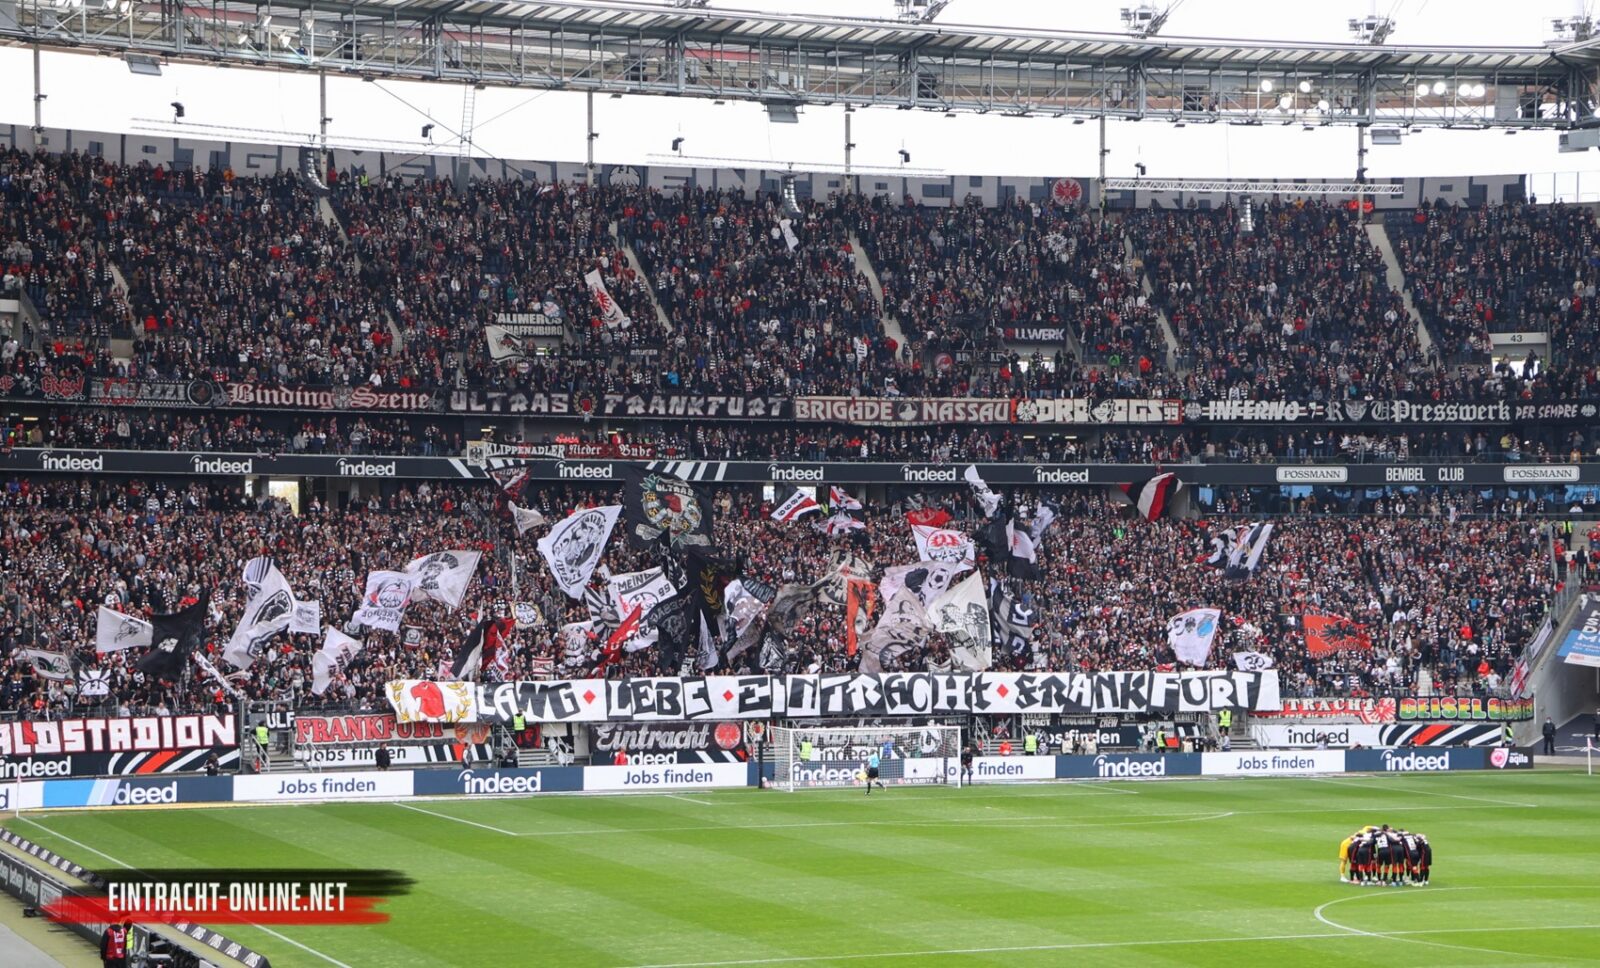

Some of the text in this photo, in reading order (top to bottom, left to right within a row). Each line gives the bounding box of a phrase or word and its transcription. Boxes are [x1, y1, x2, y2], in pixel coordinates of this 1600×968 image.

[1510, 335, 1523, 343] 43
[226, 383, 430, 409] Binding Szene
[449, 391, 788, 417] ULTRAS FRANKFURT
[795, 400, 1009, 422] BRIGADE NASSAU
[1208, 400, 1300, 421] INFERNO
[1390, 399, 1511, 422] Presswerk
[1515, 404, 1579, 420] PER SEMPRE
[43, 454, 103, 470] indeed
[194, 457, 252, 473] indeed
[340, 461, 395, 476] indeed
[559, 463, 613, 478] indeed
[771, 466, 824, 480] indeed
[904, 467, 957, 482] indeed
[1036, 468, 1089, 482] indeed
[1284, 470, 1341, 479] POSSMANN
[1386, 467, 1465, 482] BEMBEL CLUB
[1512, 470, 1572, 478] POSSMANN
[609, 679, 713, 720] LEBE
[739, 673, 993, 714] EINTRACHT
[1015, 671, 1256, 711] FRANKFURT
[596, 722, 710, 751] Eintracht
[978, 761, 1024, 775] finden
[1098, 757, 1165, 777] indeed
[1237, 755, 1315, 771] Jobs finden
[1386, 752, 1449, 770] indeed
[464, 771, 542, 793] indeed
[624, 769, 713, 786] Jobs finden
[278, 778, 376, 795] Jobs finden
